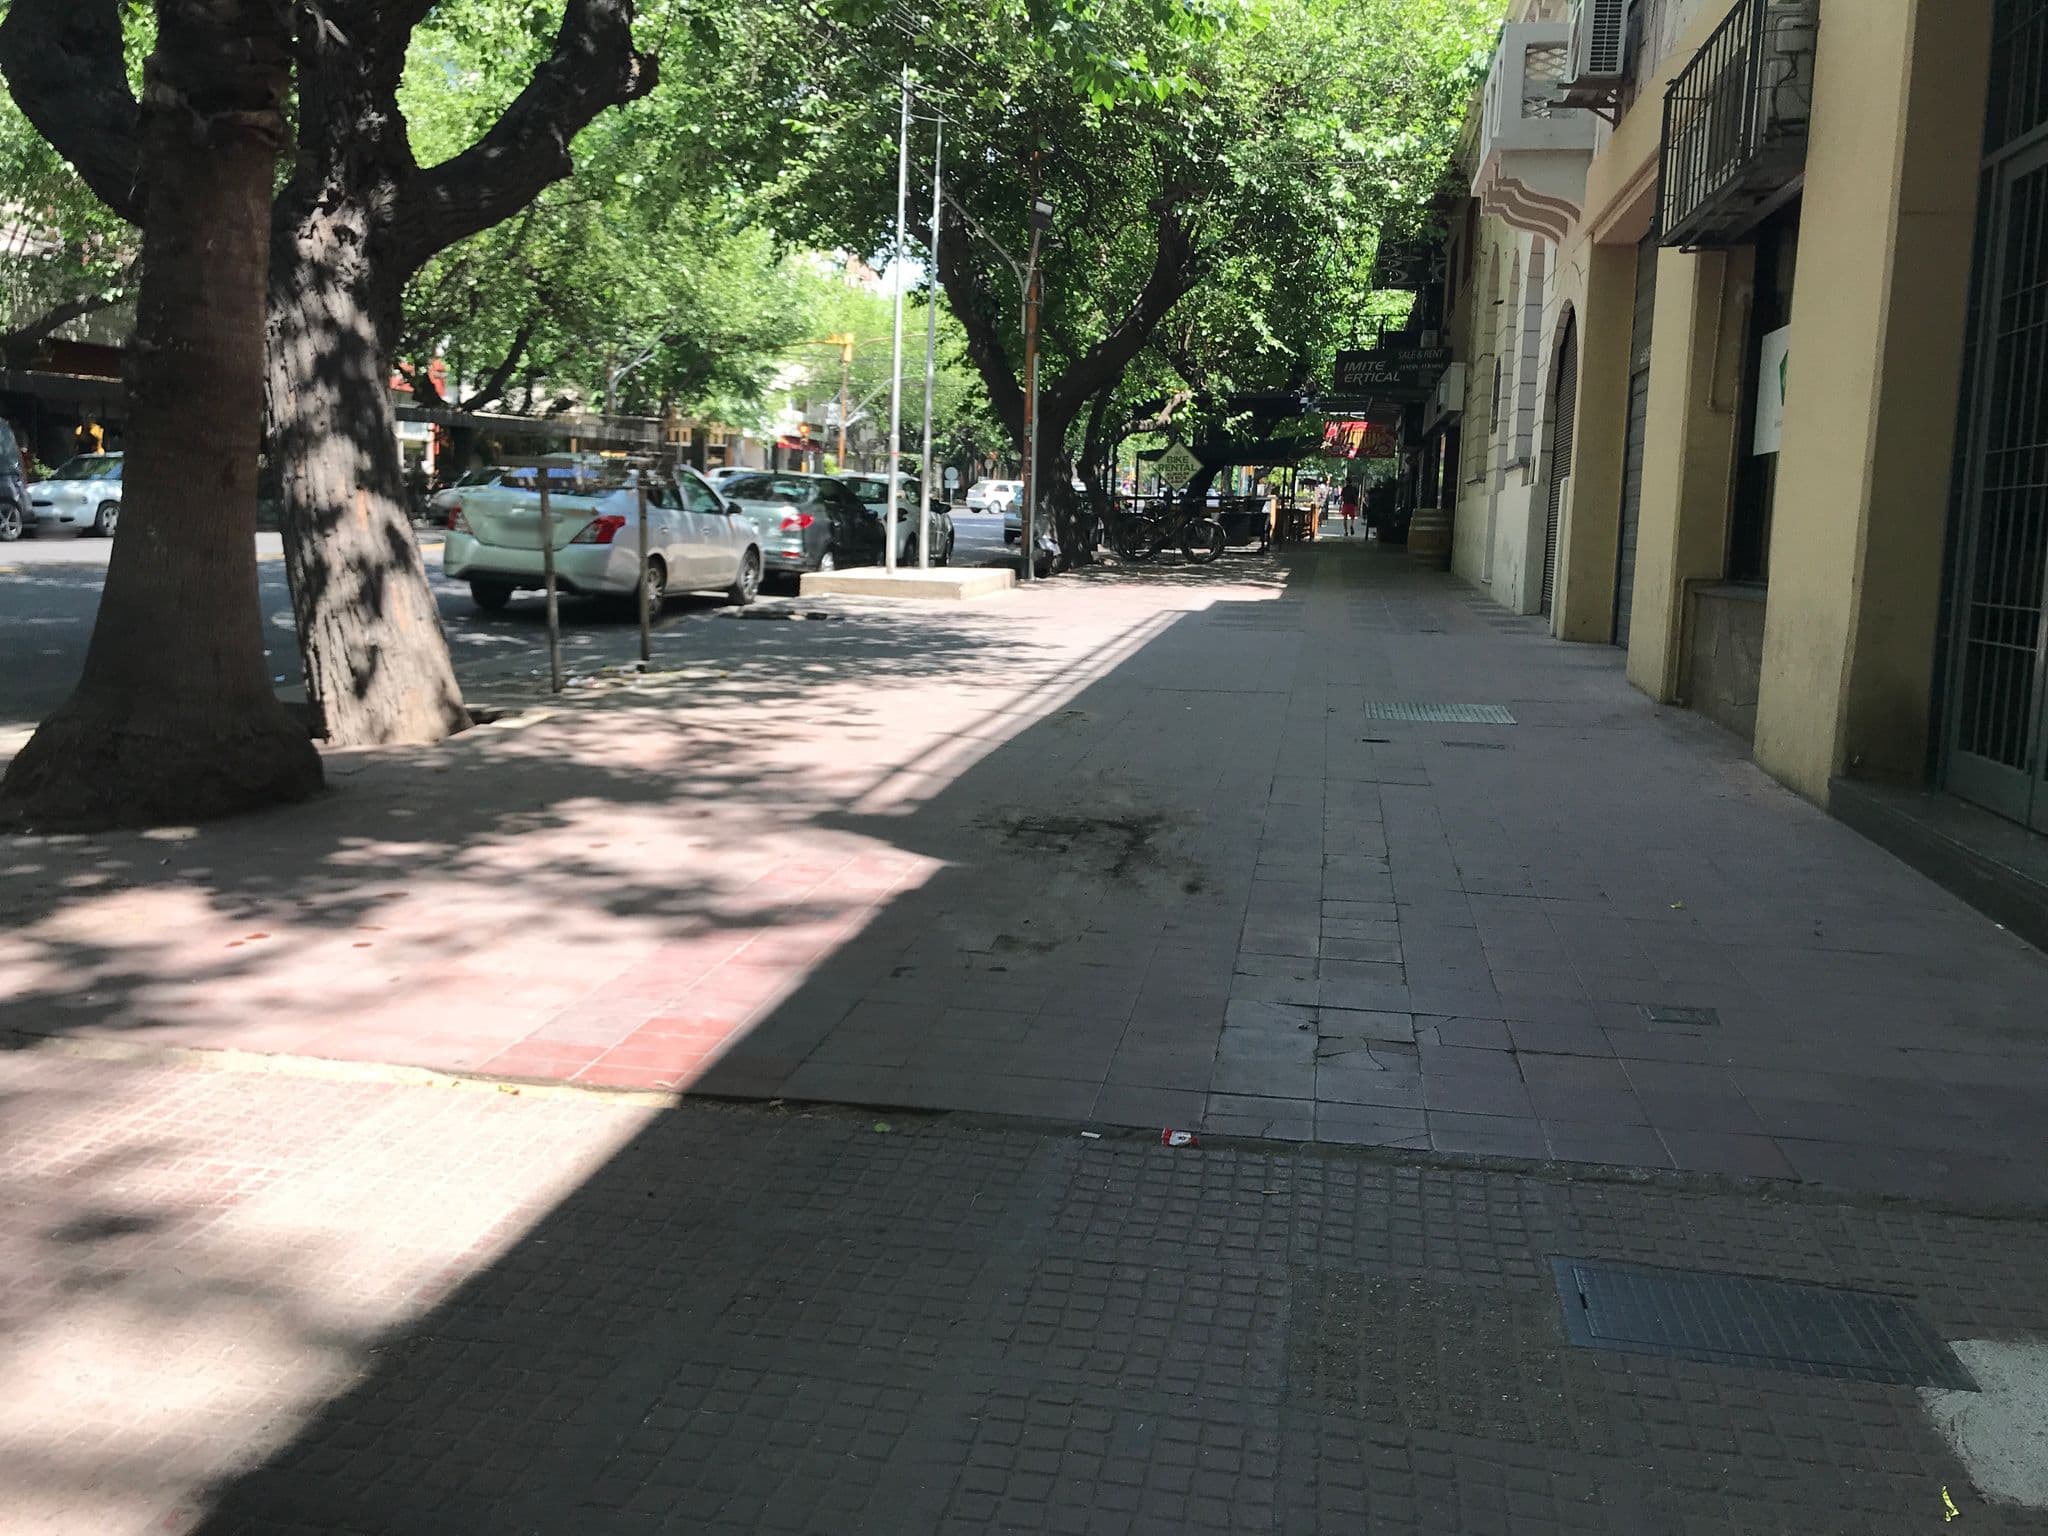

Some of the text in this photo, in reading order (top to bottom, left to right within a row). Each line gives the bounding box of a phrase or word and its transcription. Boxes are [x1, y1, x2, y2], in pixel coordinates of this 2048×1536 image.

[1398, 351, 1416, 359] SALE
[1423, 350, 1443, 358] RENT
[1166, 455, 1189, 463] BIKE
[1158, 463, 1196, 471] RENTAL
